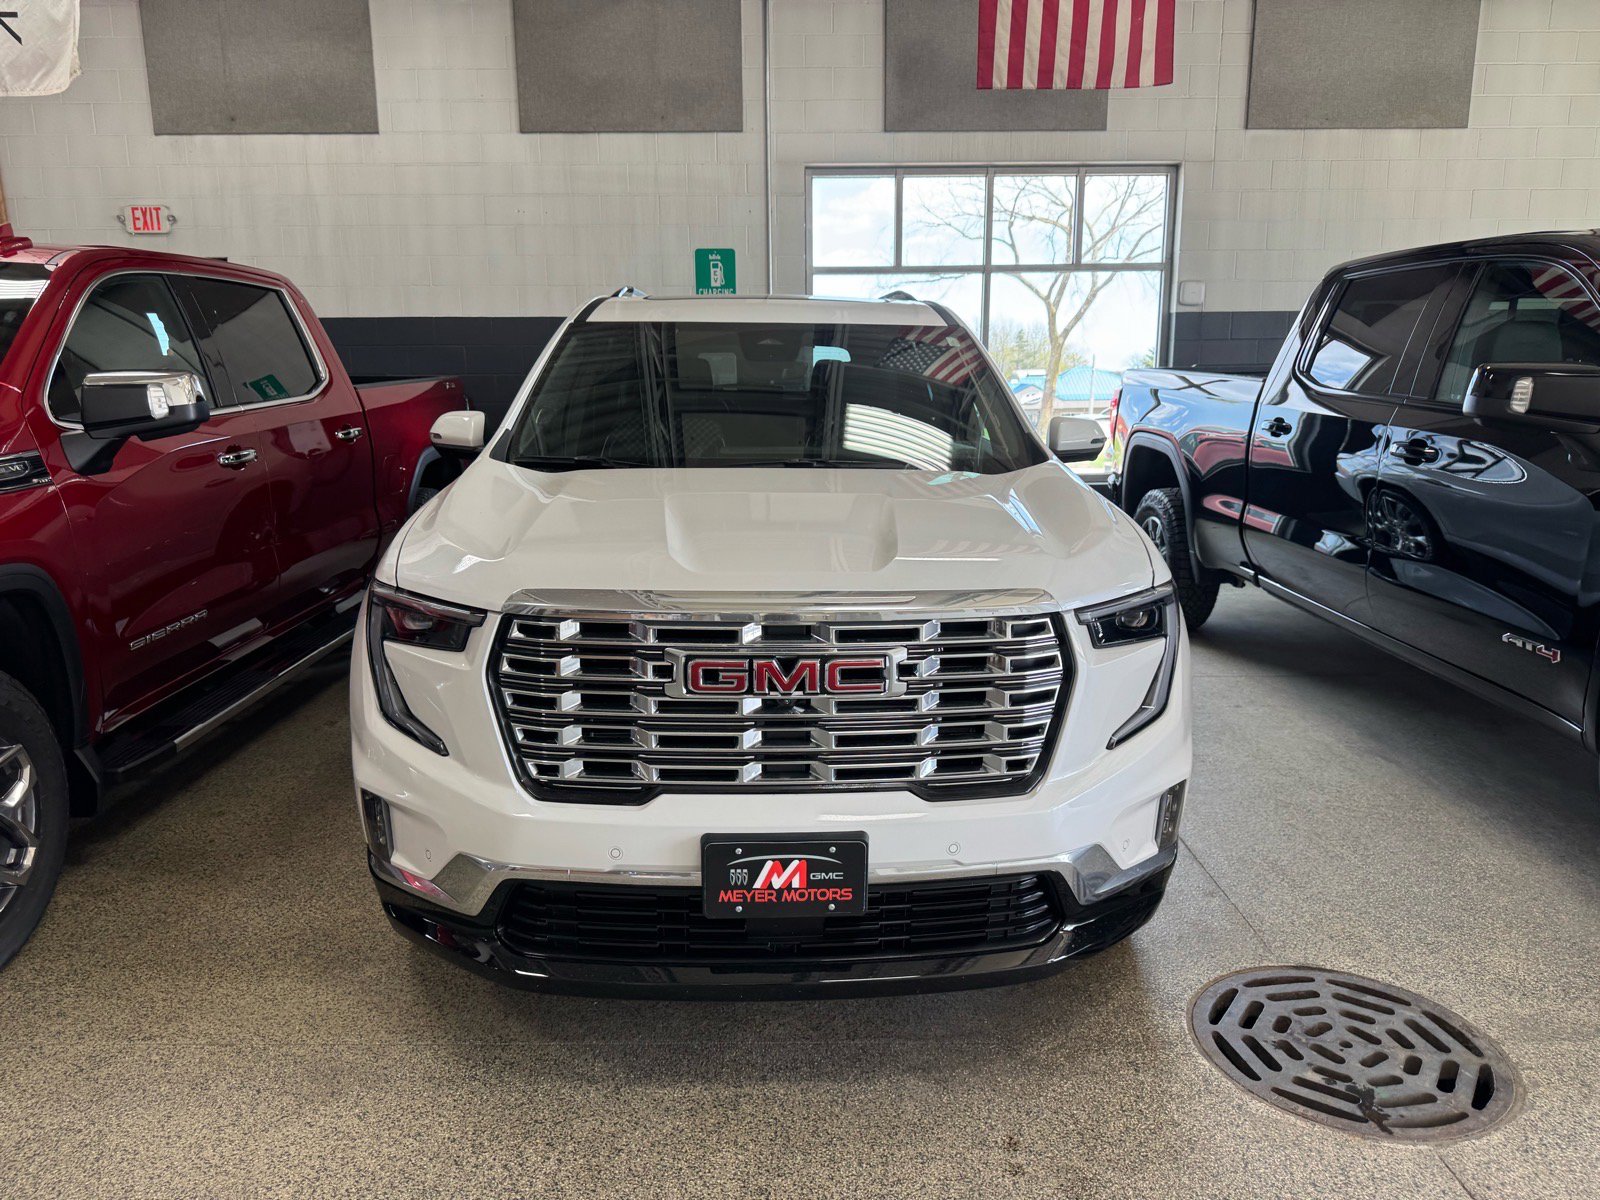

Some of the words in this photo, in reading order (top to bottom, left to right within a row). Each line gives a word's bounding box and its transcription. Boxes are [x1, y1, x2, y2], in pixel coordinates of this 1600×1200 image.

[131, 206, 161, 231] EXIT
[129, 609, 208, 651] SIERRA
[1502, 632, 1561, 663] AT4
[687, 657, 886, 694] GMC
[810, 872, 844, 880] GMC
[718, 889, 777, 903] MEYER
[781, 888, 853, 903] MOTORS
